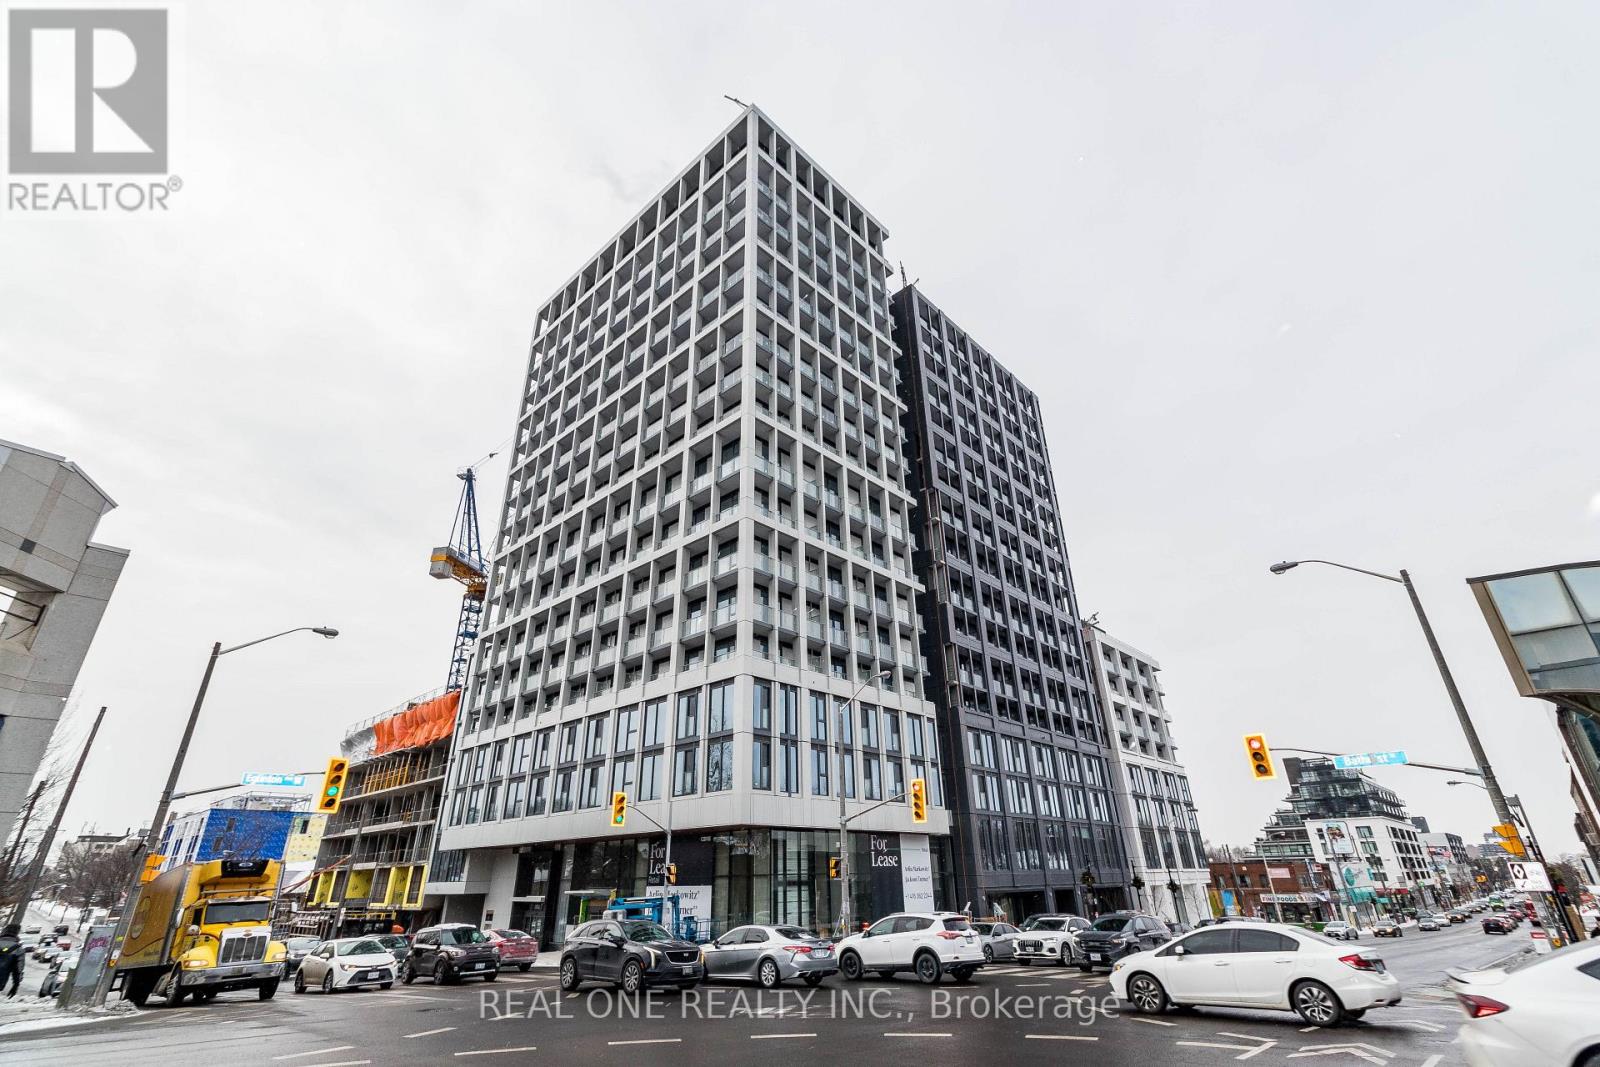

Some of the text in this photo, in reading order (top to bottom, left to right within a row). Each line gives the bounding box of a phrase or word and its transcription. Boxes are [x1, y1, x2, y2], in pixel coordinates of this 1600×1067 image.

[649, 842, 665, 859] For
[870, 834, 887, 853] For
[648, 859, 666, 875] Lea
[871, 851, 898, 867] Lease
